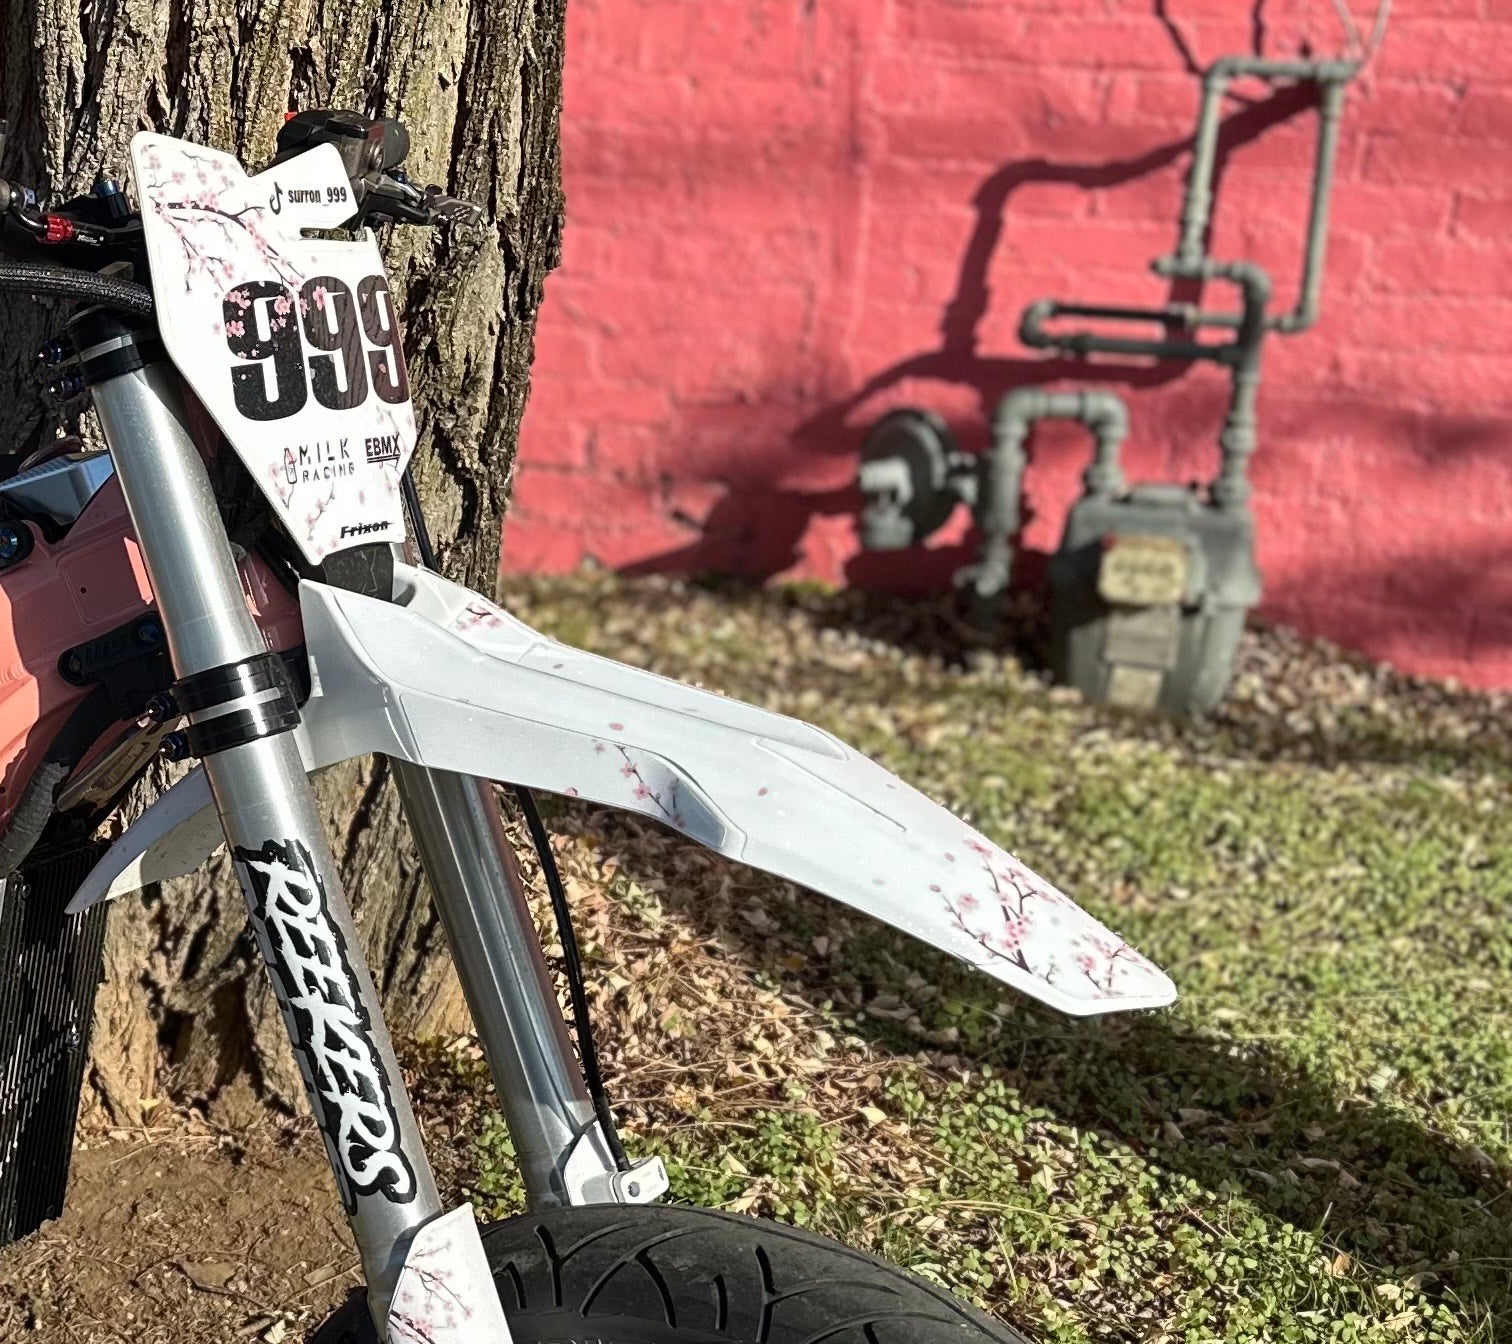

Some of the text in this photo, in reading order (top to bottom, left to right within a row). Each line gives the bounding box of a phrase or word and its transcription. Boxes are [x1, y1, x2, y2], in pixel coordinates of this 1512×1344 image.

[287, 186, 347, 207] surron_999
[222, 274, 411, 422] 999
[298, 437, 350, 466] MILK
[364, 432, 401, 458] EBMX
[302, 462, 355, 483] RACING
[339, 520, 391, 539] Frixon
